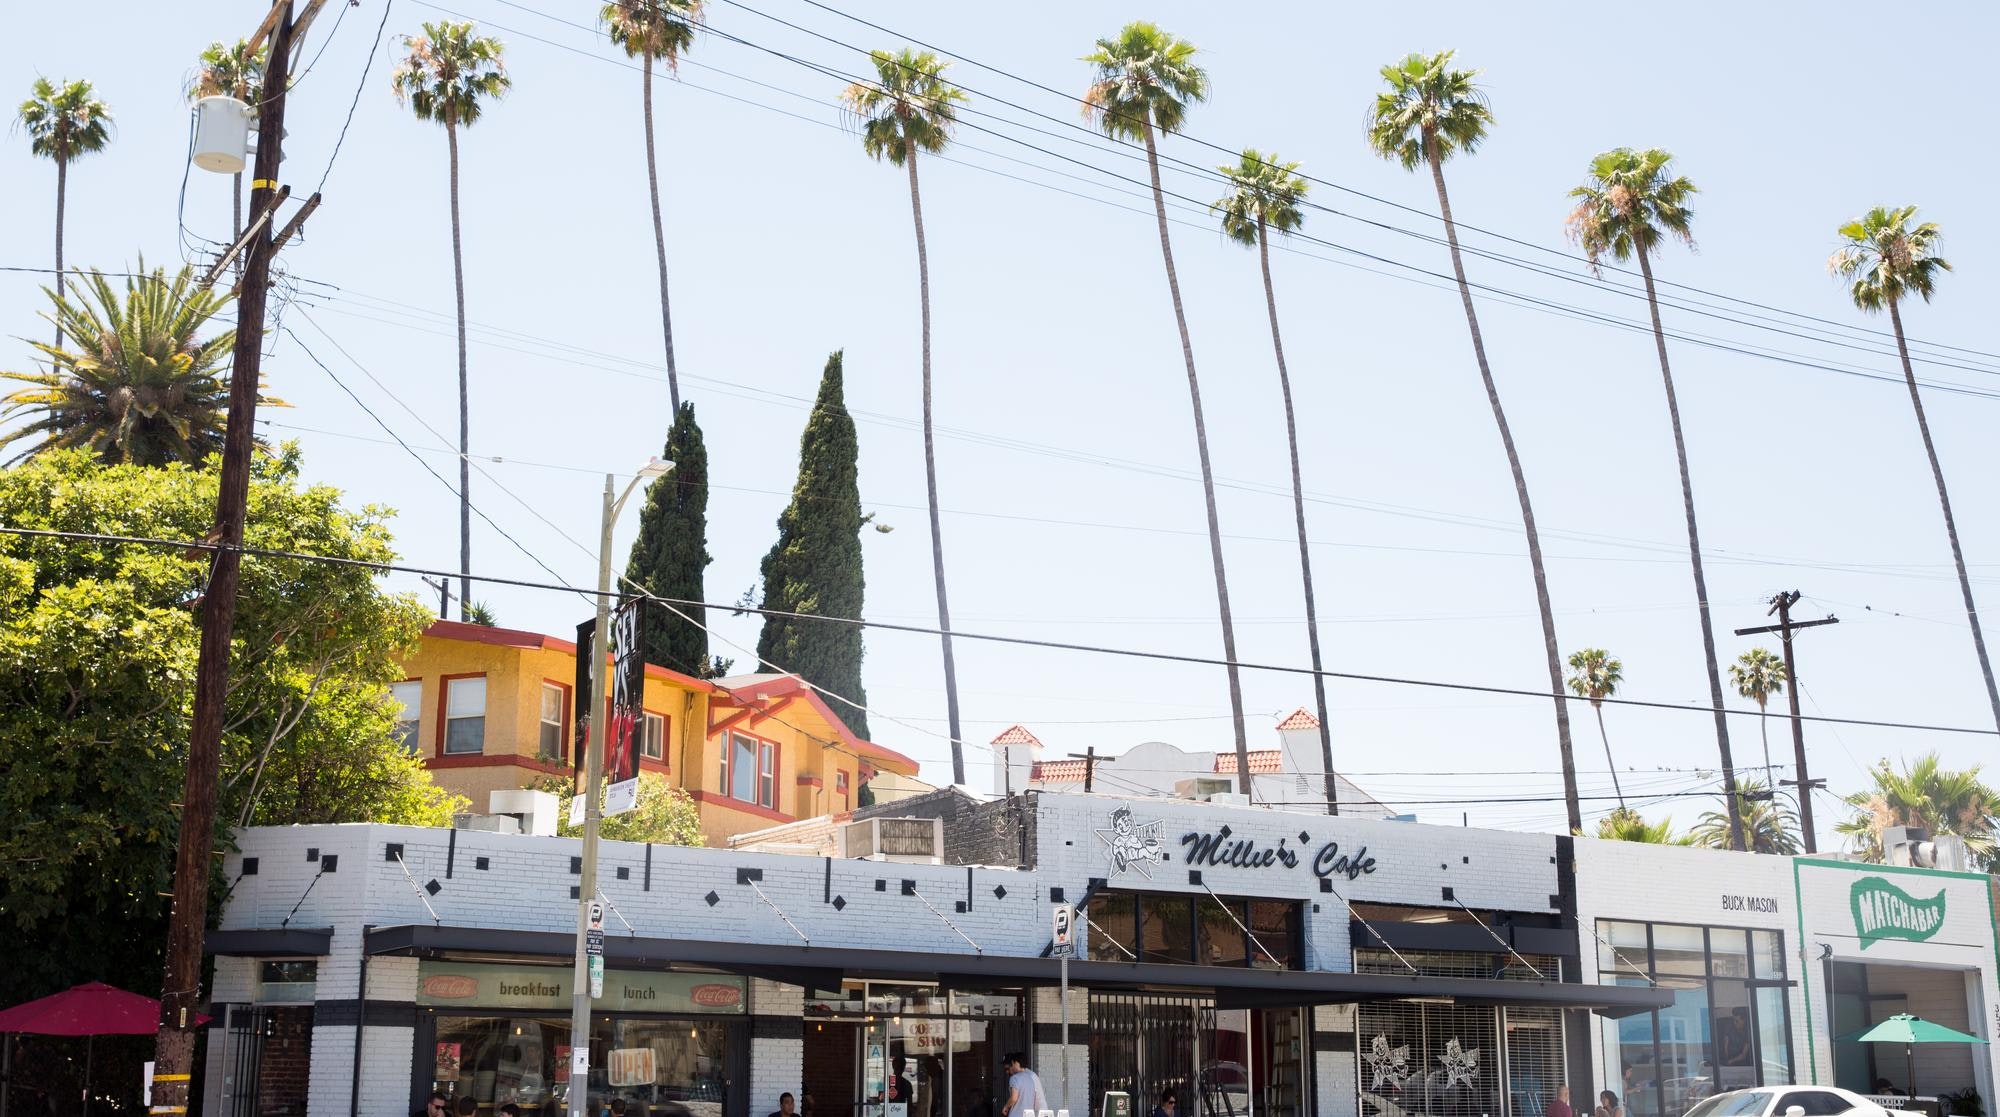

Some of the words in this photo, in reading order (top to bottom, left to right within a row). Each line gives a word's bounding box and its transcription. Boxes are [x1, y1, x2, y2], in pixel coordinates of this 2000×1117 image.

[1182, 832, 1299, 870] Millie's
[1313, 842, 1377, 880] Cafe
[1722, 895, 1746, 911] BUCK
[1747, 897, 1778, 913] MASON
[1859, 890, 1940, 933] MATCHABAR
[500, 981, 560, 997] breakfast
[624, 985, 656, 1000] lunch
[909, 1022, 962, 1035] COFFE
[917, 1036, 946, 1048] SHO
[872, 1046, 880, 1057] A
